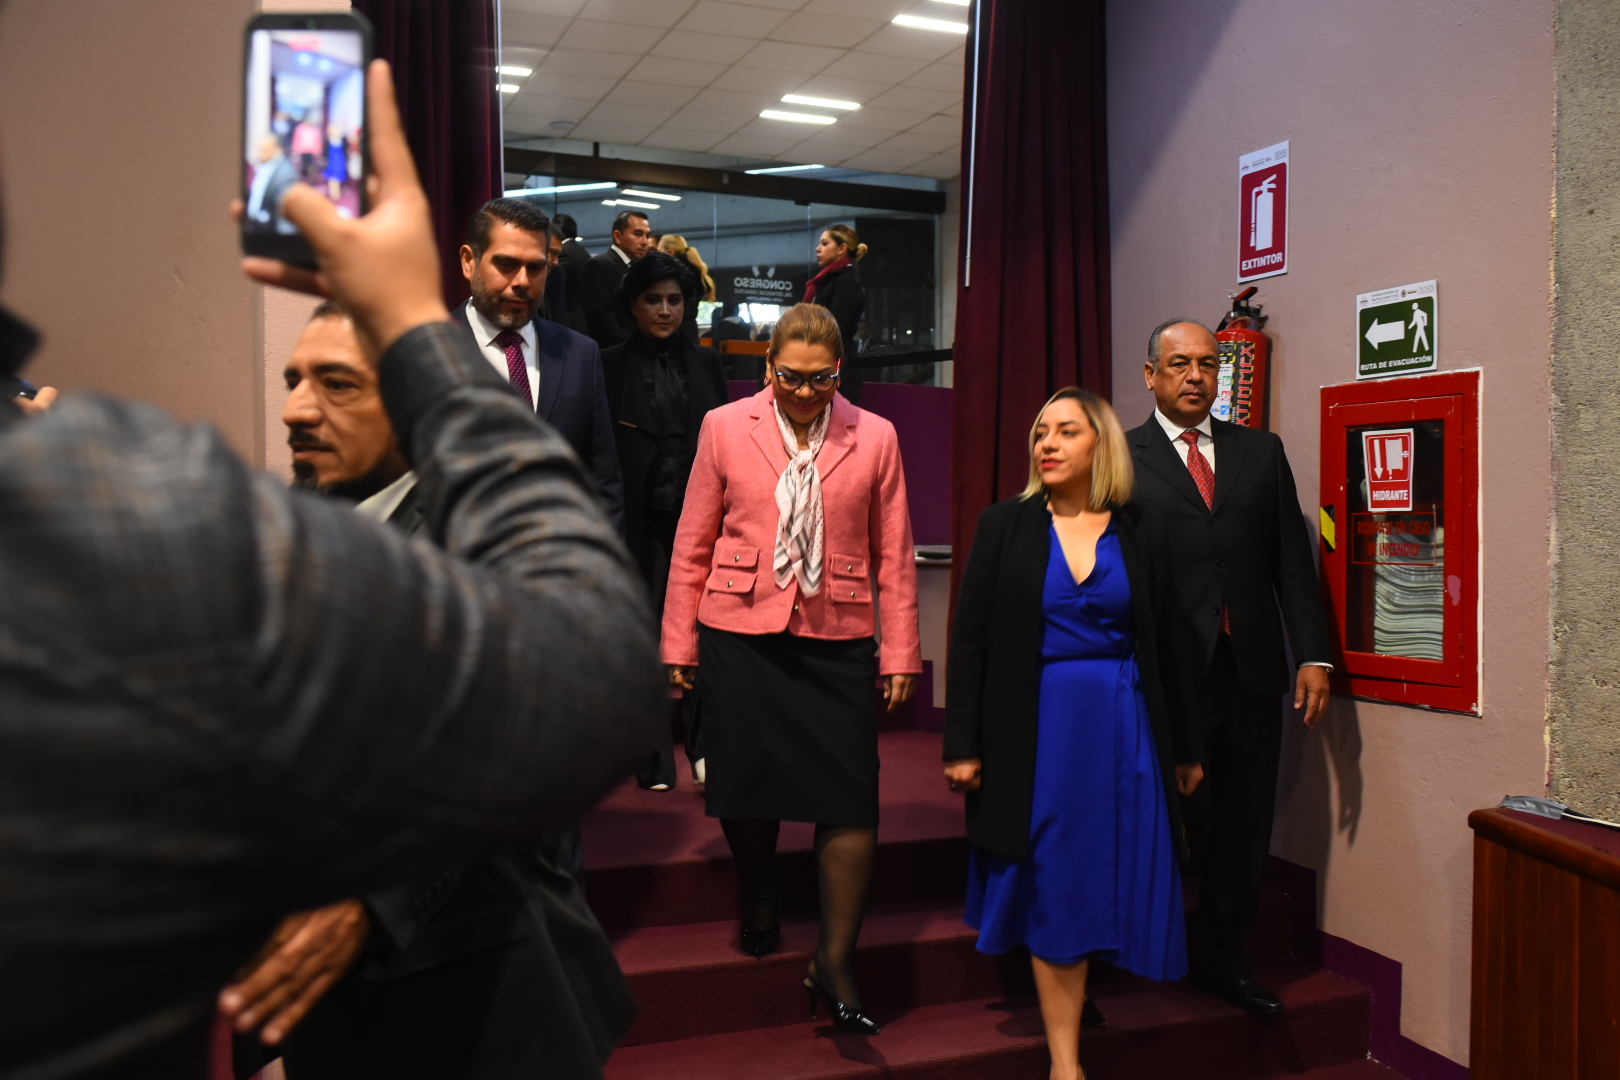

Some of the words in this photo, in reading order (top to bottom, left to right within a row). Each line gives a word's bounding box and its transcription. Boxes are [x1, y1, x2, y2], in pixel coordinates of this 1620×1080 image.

[1241, 252, 1283, 271] EXTINTOR
[1360, 362, 1377, 371] RUTA
[1378, 361, 1388, 369] DE
[1389, 355, 1432, 368] EVACUACIÓN
[1236, 345, 1254, 427] XTINMEX
[1372, 490, 1408, 501] HIDRANTE
[1395, 521, 1407, 535] EN
[1409, 521, 1432, 535] CASO
[1380, 542, 1420, 557] INCENDIO
